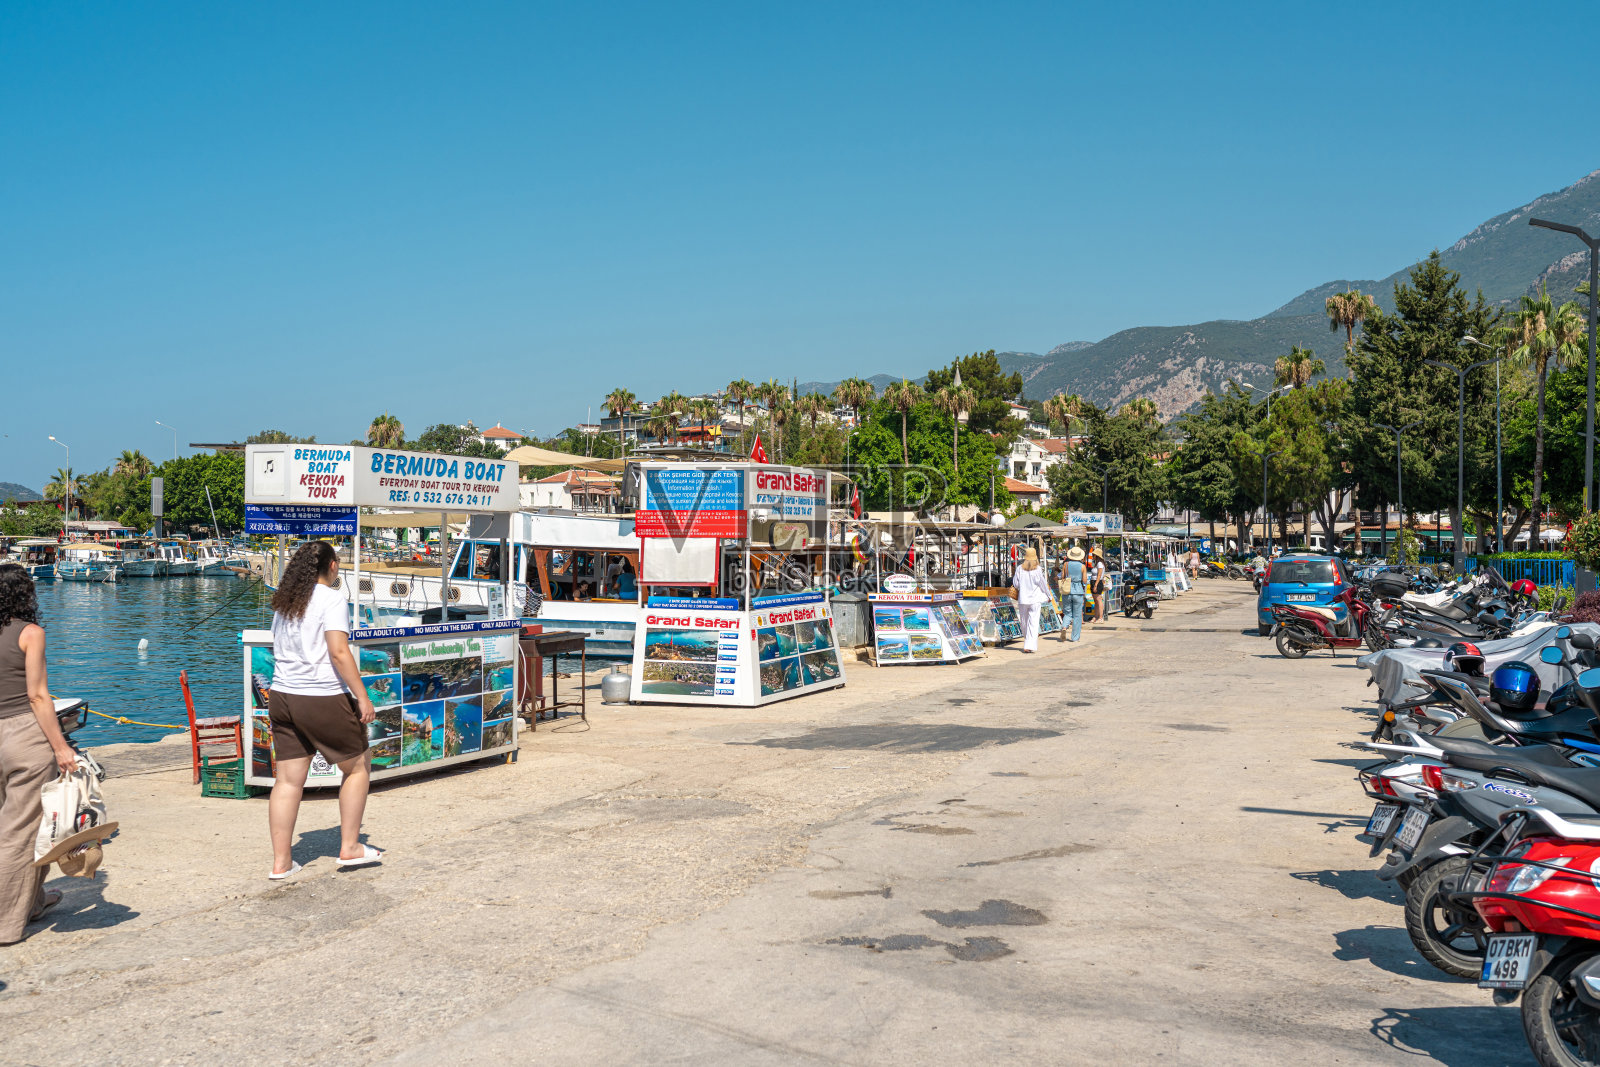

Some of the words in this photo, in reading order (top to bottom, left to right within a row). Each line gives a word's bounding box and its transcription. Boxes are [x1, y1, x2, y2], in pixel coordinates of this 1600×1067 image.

[294, 448, 350, 461] BERMUDA
[308, 462, 338, 473] BOAT
[371, 453, 458, 478] BERMUDA
[464, 461, 506, 482] BOAT
[300, 474, 344, 486] KEKOVA
[380, 478, 419, 488] EVERYDAY
[421, 480, 440, 490] BOAT
[442, 482, 460, 491] TOUR
[462, 483, 471, 491] TO
[473, 484, 499, 493] KEKOVA
[757, 470, 791, 490] Grand
[794, 474, 826, 493] Safari
[308, 487, 337, 499] TOUR
[389, 490, 410, 502] RES:
[413, 491, 420, 502] 0
[423, 492, 442, 503] 532
[445, 493, 463, 504] 676
[467, 495, 478, 505] 24
[646, 616, 690, 626] Grand
[695, 618, 740, 629] Safari
[769, 611, 793, 624] Grand
[794, 606, 816, 620] Safari
[1494, 960, 1518, 984] 498
